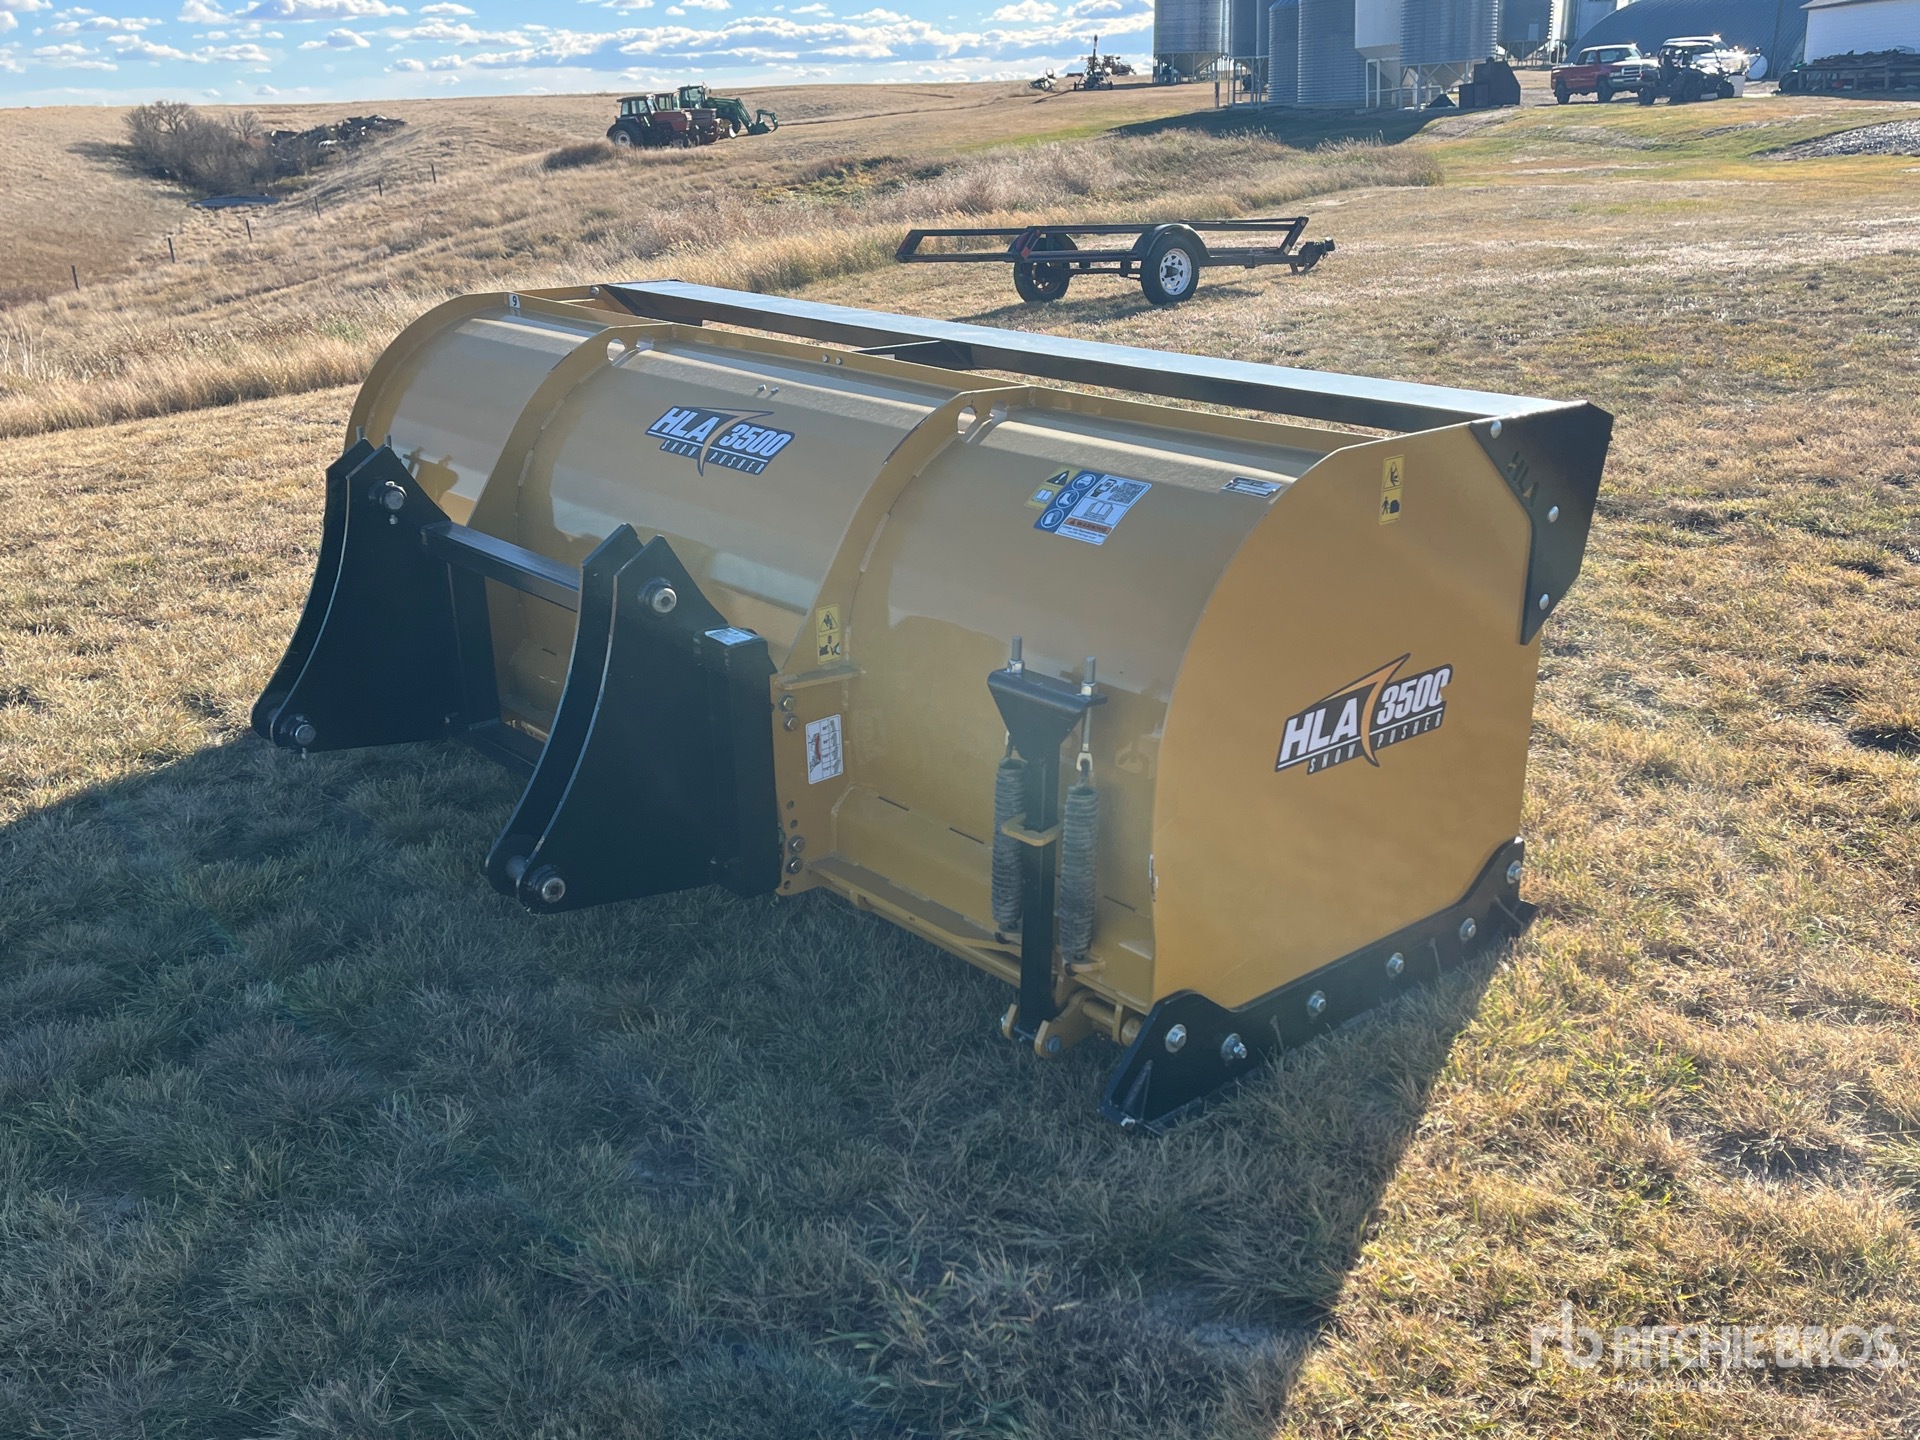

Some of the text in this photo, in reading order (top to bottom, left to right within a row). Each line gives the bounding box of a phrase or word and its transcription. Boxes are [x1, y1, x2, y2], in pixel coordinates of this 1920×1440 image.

[650, 407, 792, 457] HLA 3500
[661, 439, 765, 474] SNOW PUSHER
[1507, 451, 1539, 506] HLA
[1279, 667, 1450, 762] HLA 3500
[1309, 713, 1441, 773] SNOW PUSHER
